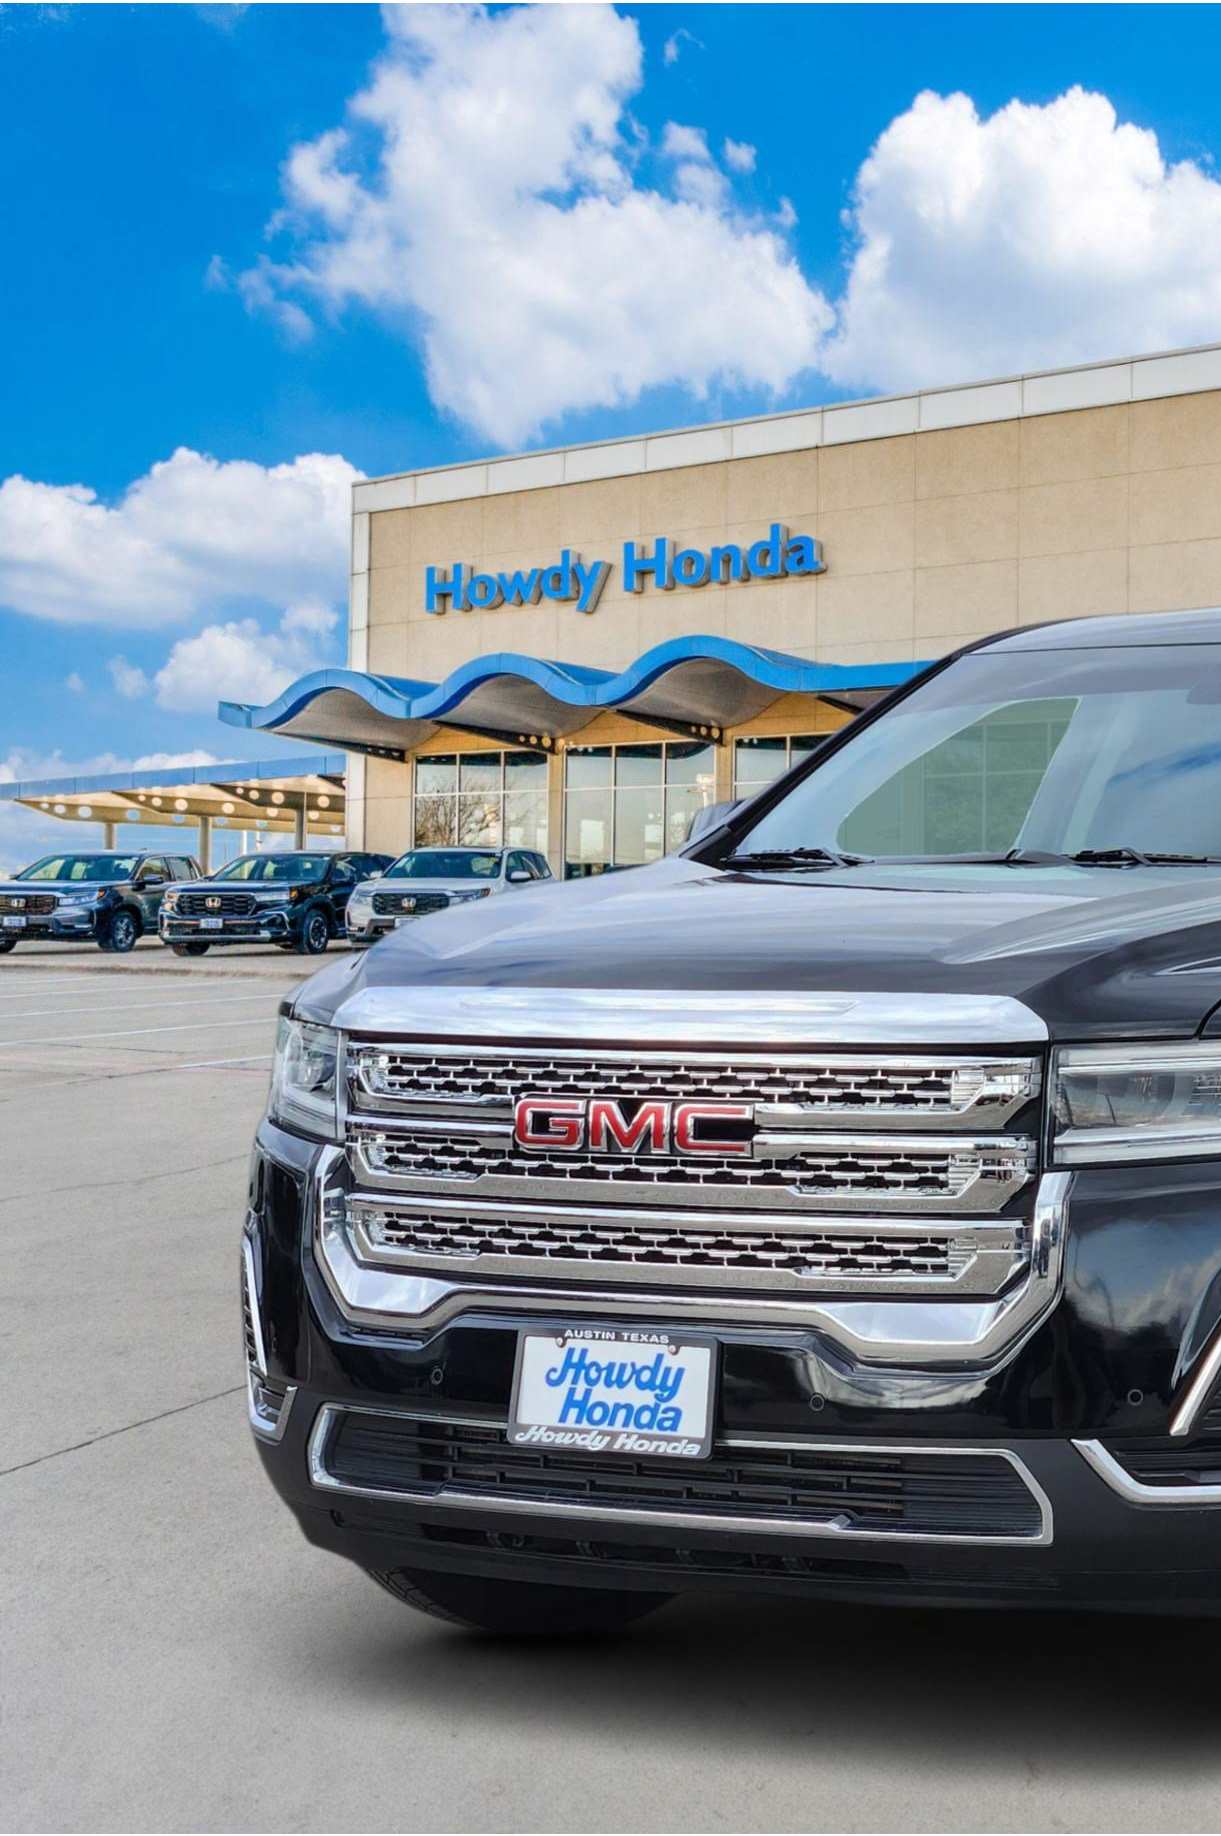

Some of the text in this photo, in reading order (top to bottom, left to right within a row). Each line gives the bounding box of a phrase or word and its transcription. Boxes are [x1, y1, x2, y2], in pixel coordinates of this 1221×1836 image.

[425, 522, 827, 615] Howdy Honda
[514, 1098, 754, 1158] GMC
[563, 1329, 670, 1344] AUSTIN TEXAS
[545, 1346, 686, 1403] Howdy
[557, 1387, 684, 1433] Honda
[515, 1425, 702, 1456] Howdy Honda
